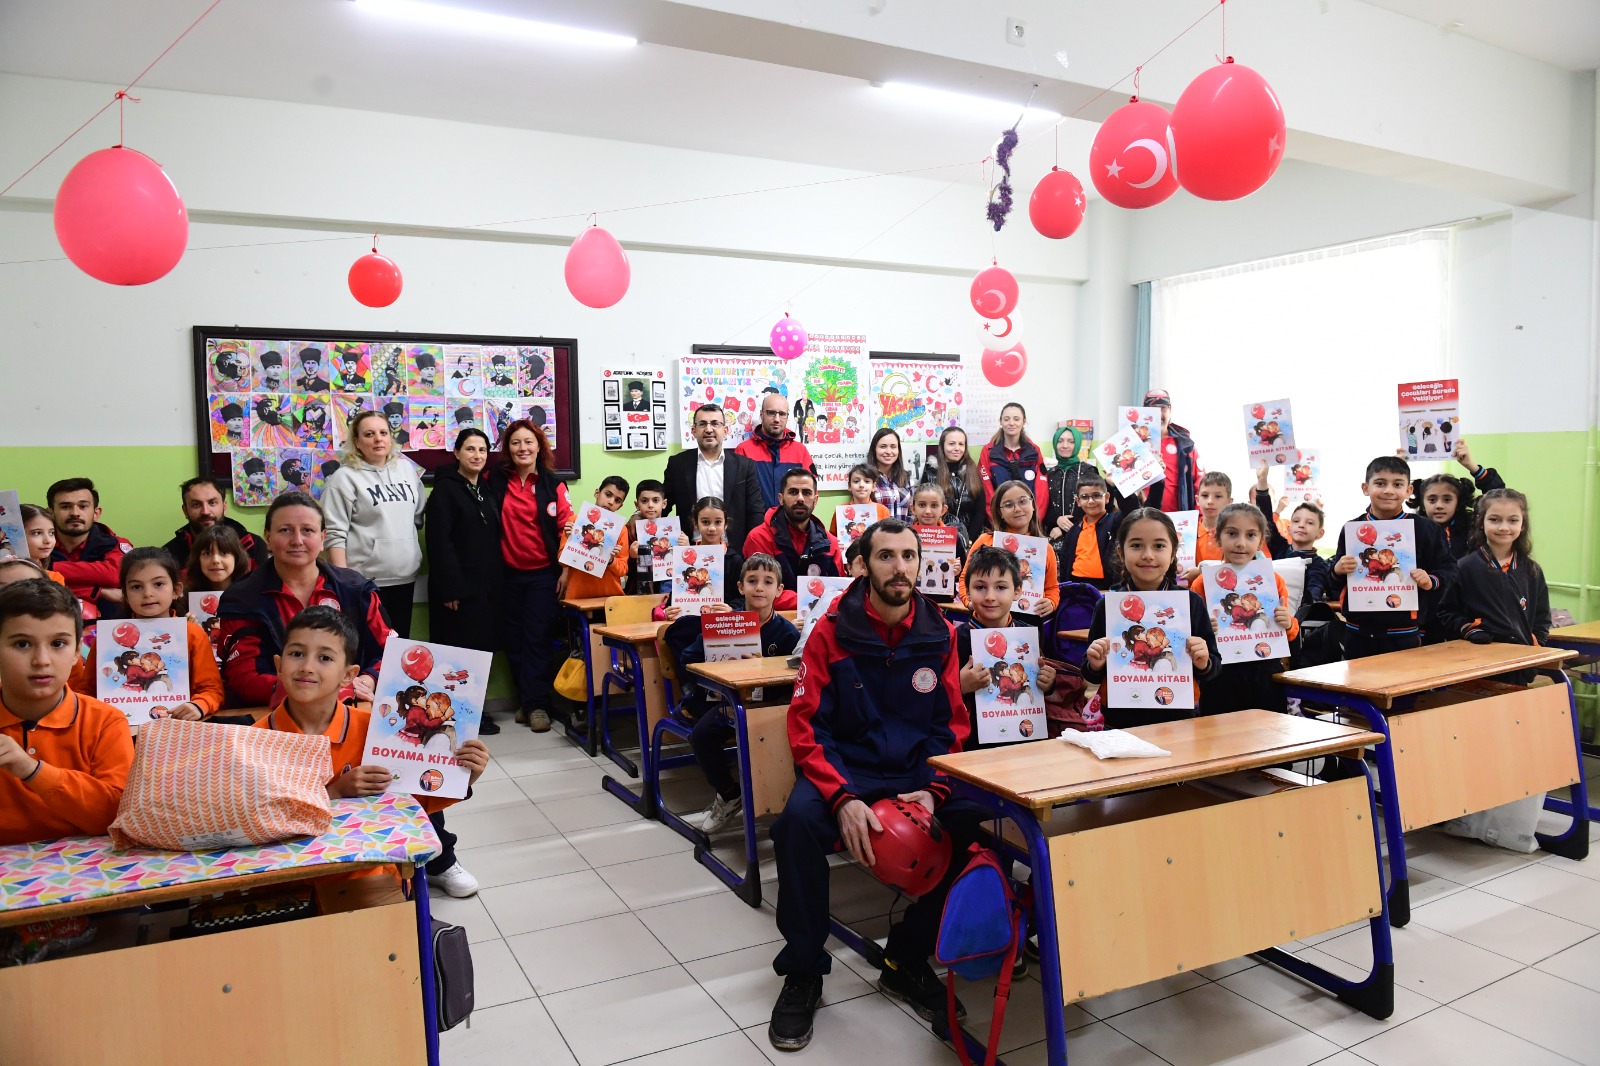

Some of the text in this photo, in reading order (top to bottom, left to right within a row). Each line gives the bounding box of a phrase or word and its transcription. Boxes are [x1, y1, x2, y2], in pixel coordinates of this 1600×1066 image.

[702, 367, 755, 376] CUMHURİYET
[691, 377, 752, 386] ÇOCUKLARIYIZ
[566, 545, 589, 558] BOYAMA
[1387, 584, 1415, 592] KİTABI
[1217, 630, 1284, 643] BOYAMA KİTABI
[1113, 673, 1190, 683] BOYAMA KİTABI
[103, 694, 187, 704] BOYAMA KİTABI
[981, 707, 1044, 719] BOYAMA KİTABI
[371, 746, 424, 762] BOYAMA
